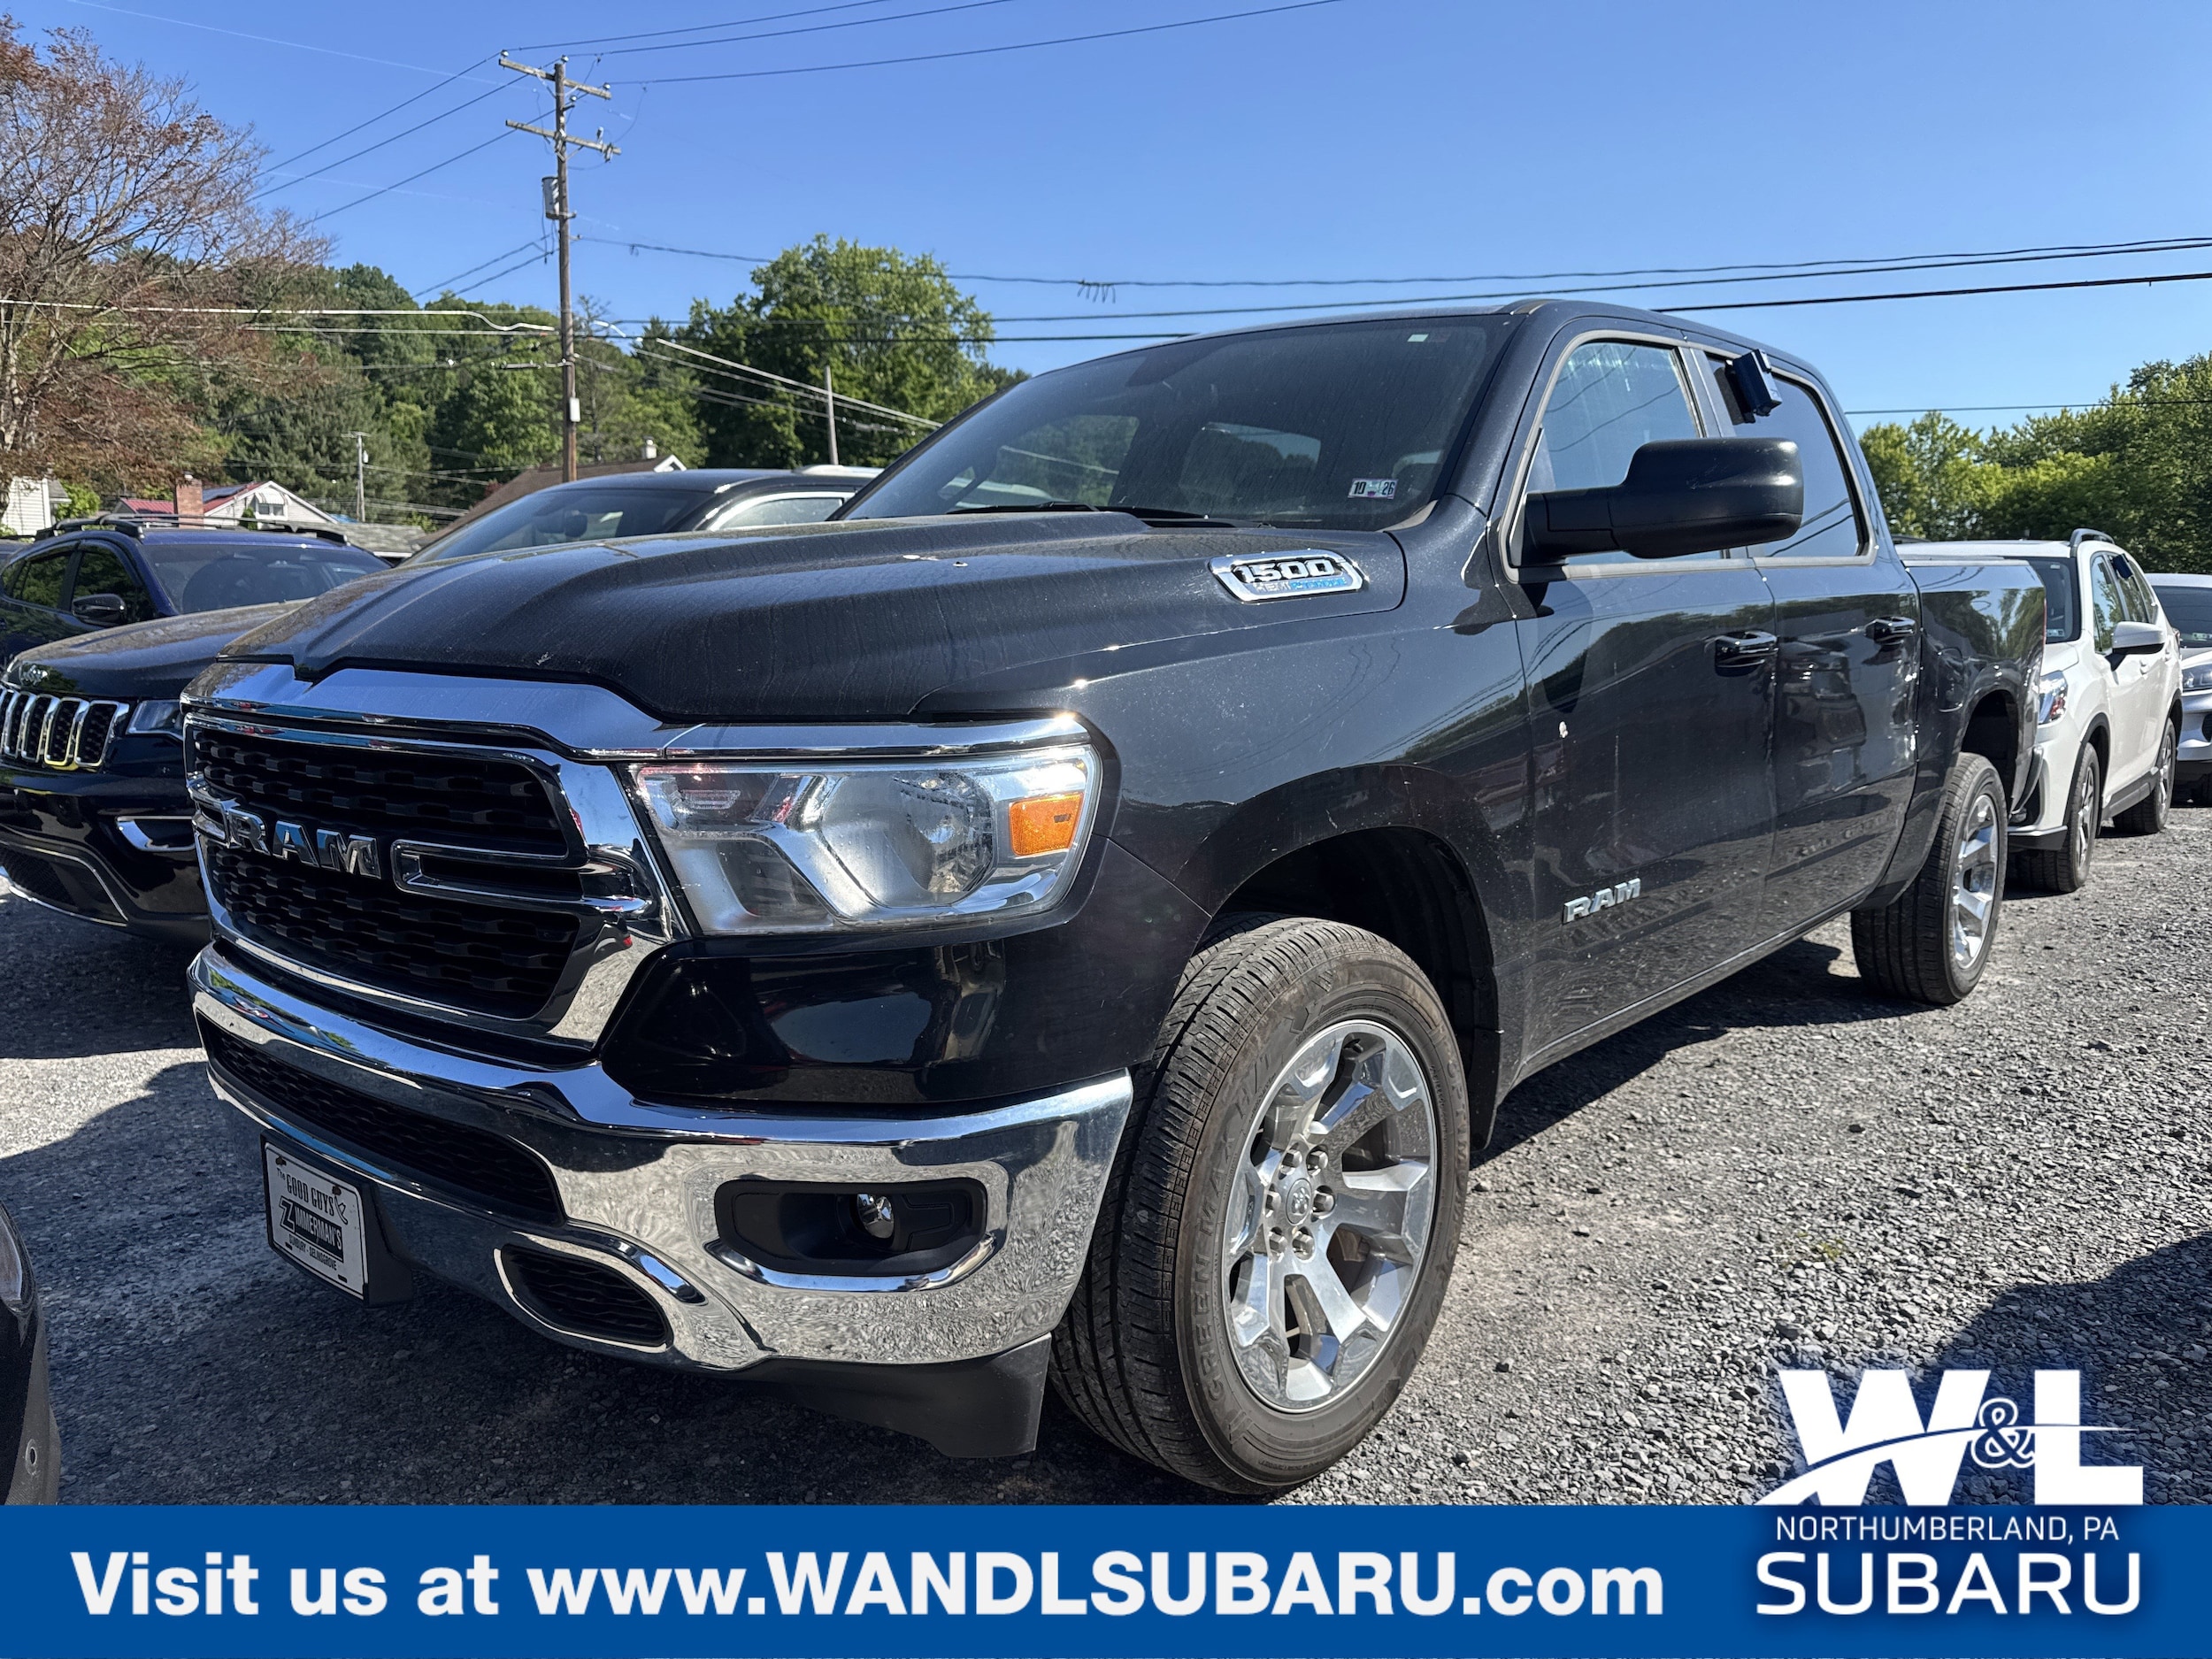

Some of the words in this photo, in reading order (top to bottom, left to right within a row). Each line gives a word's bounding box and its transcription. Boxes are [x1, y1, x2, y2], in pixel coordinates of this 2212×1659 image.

[1353, 481, 1367, 495] 10
[1381, 481, 1395, 495] 26
[1233, 558, 1335, 584] 1500
[227, 808, 382, 879] RAM
[1562, 877, 1640, 926] RAM
[277, 1167, 286, 1181] The
[287, 1173, 310, 1204] GOOD
[311, 1187, 335, 1217] GUYS
[279, 1195, 342, 1251] ZIMMERMAN'S
